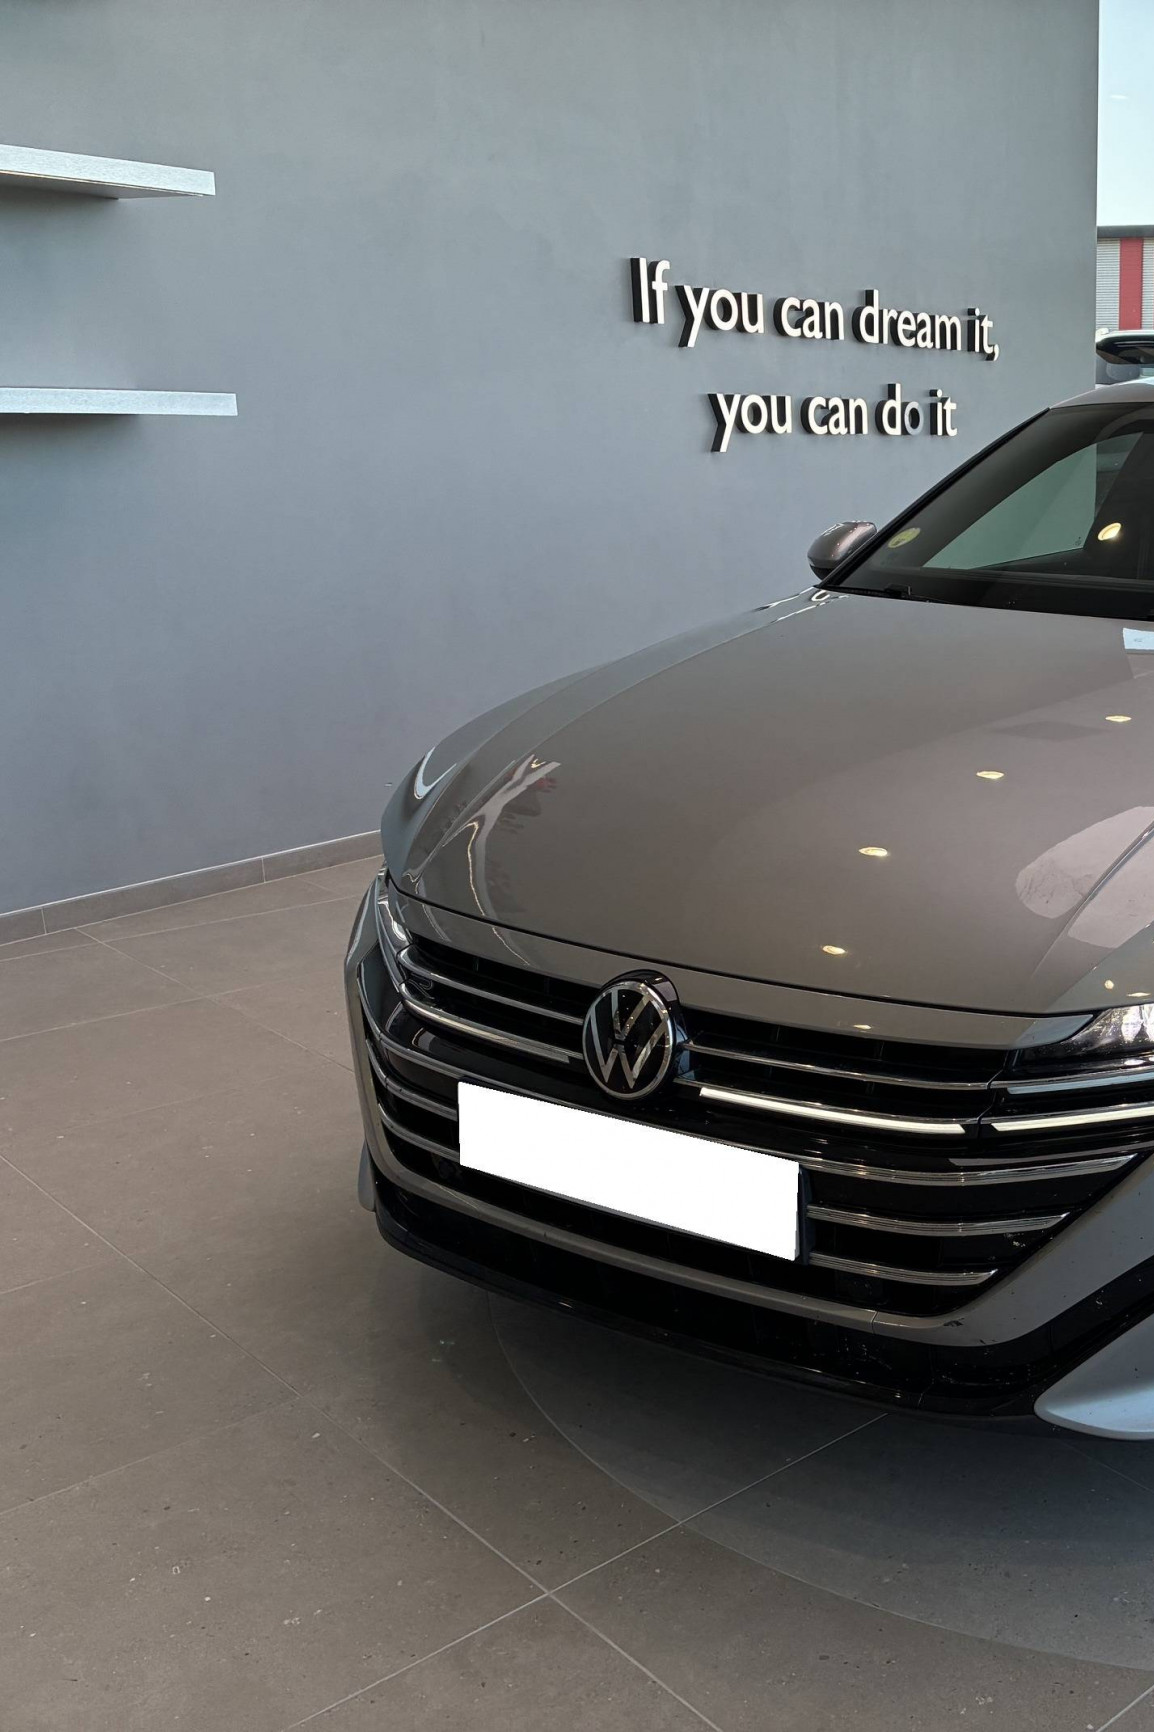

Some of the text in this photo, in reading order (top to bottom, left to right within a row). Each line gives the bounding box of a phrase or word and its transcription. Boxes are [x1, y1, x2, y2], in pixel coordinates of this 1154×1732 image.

[630, 257, 1000, 362] If you can dream it,
[708, 383, 958, 453] you can do it
